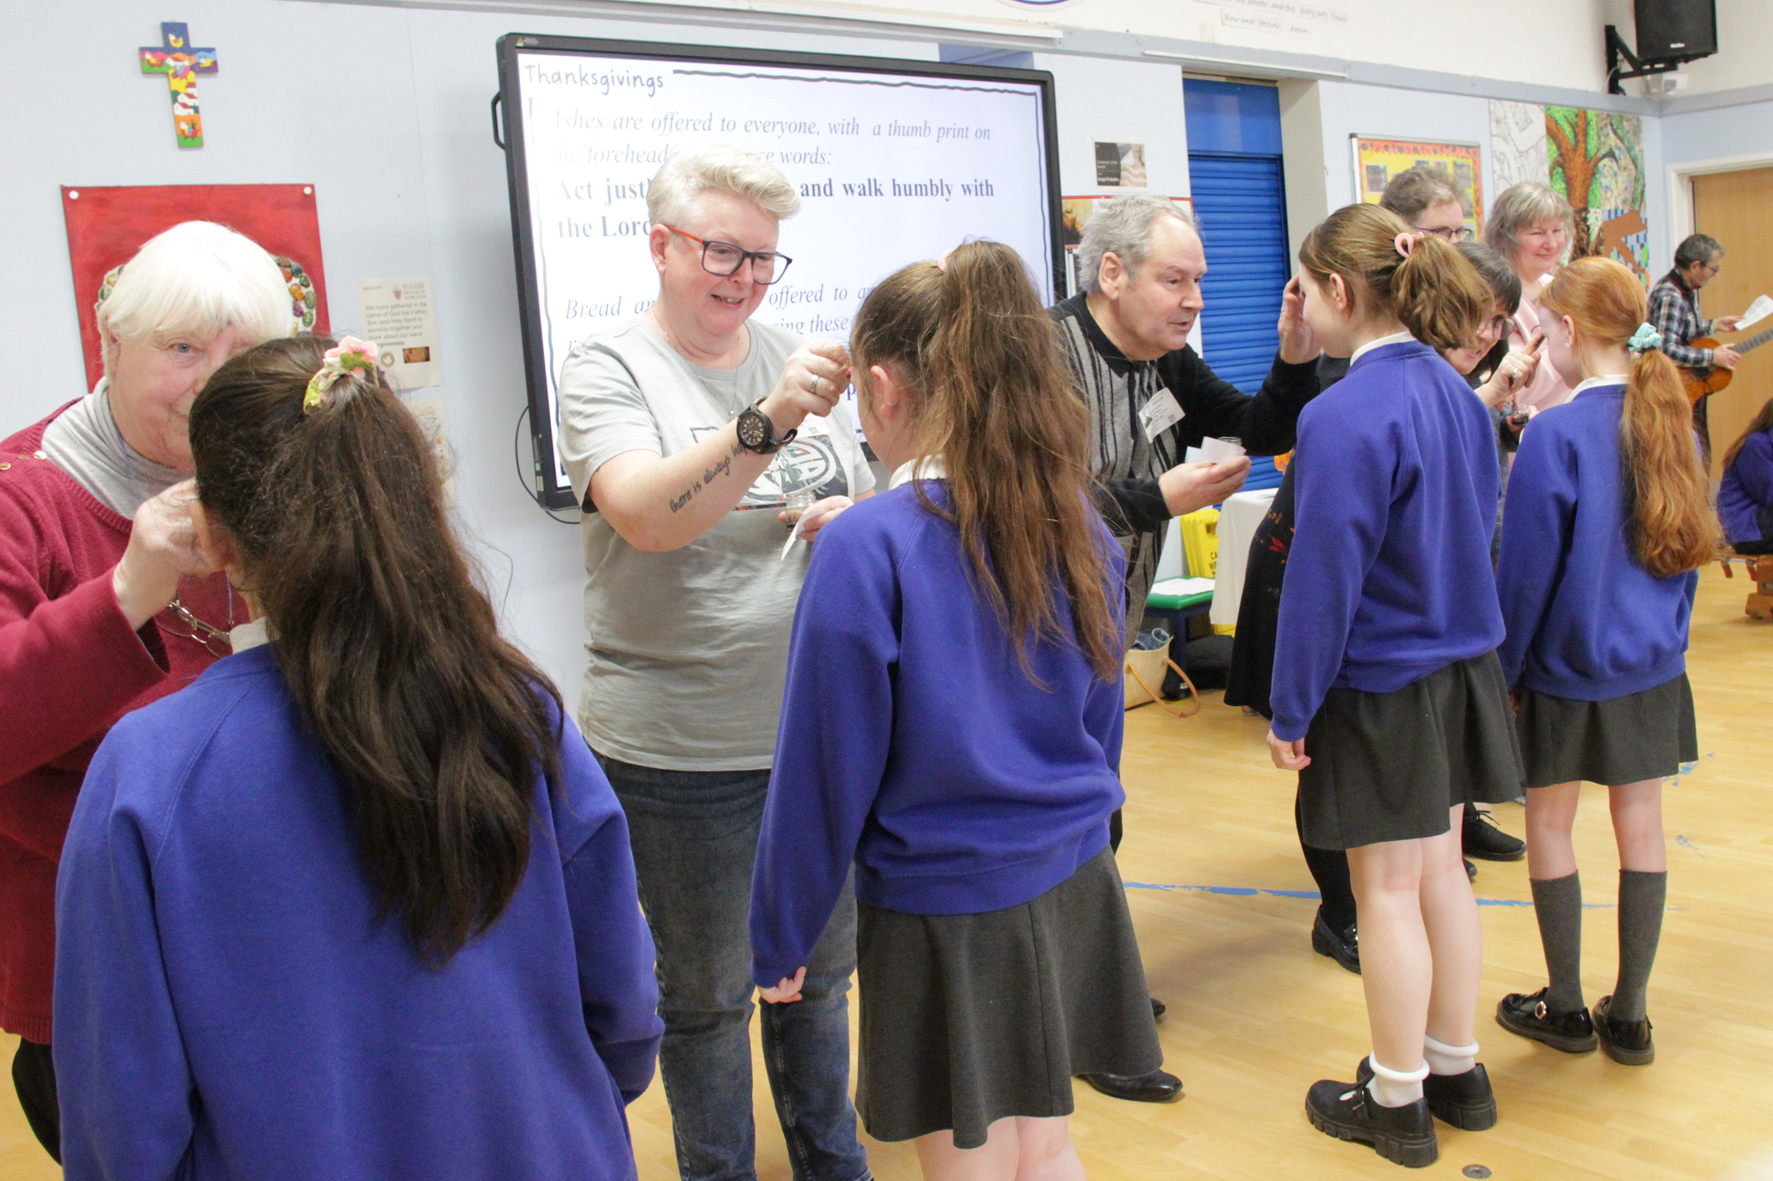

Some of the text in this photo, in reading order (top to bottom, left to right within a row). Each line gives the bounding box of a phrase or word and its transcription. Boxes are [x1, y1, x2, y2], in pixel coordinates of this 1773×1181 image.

[524, 63, 664, 97] Thanksgivings
[613, 115, 643, 130] are
[651, 110, 714, 136] offered
[720, 116, 737, 132] to
[744, 119, 820, 138] everyone,
[827, 117, 860, 136] with
[873, 122, 882, 136] a
[888, 119, 931, 138] thumb
[936, 122, 969, 143] print
[975, 126, 992, 140] on
[779, 146, 832, 165] words:
[556, 180, 594, 200] Act
[800, 178, 834, 197] and
[842, 178, 884, 197] walk
[891, 178, 953, 202] humbly
[961, 178, 994, 197] with
[557, 217, 593, 238] the
[390, 302, 412, 310] gathered
[566, 296, 622, 319] Bread
[768, 283, 824, 310] offered
[833, 286, 848, 301] to
[390, 325, 411, 333] together
[809, 314, 849, 333] these
[377, 340, 405, 348] rgiveness
[669, 489, 692, 513] there
[690, 481, 702, 494] is
[703, 455, 731, 484] always
